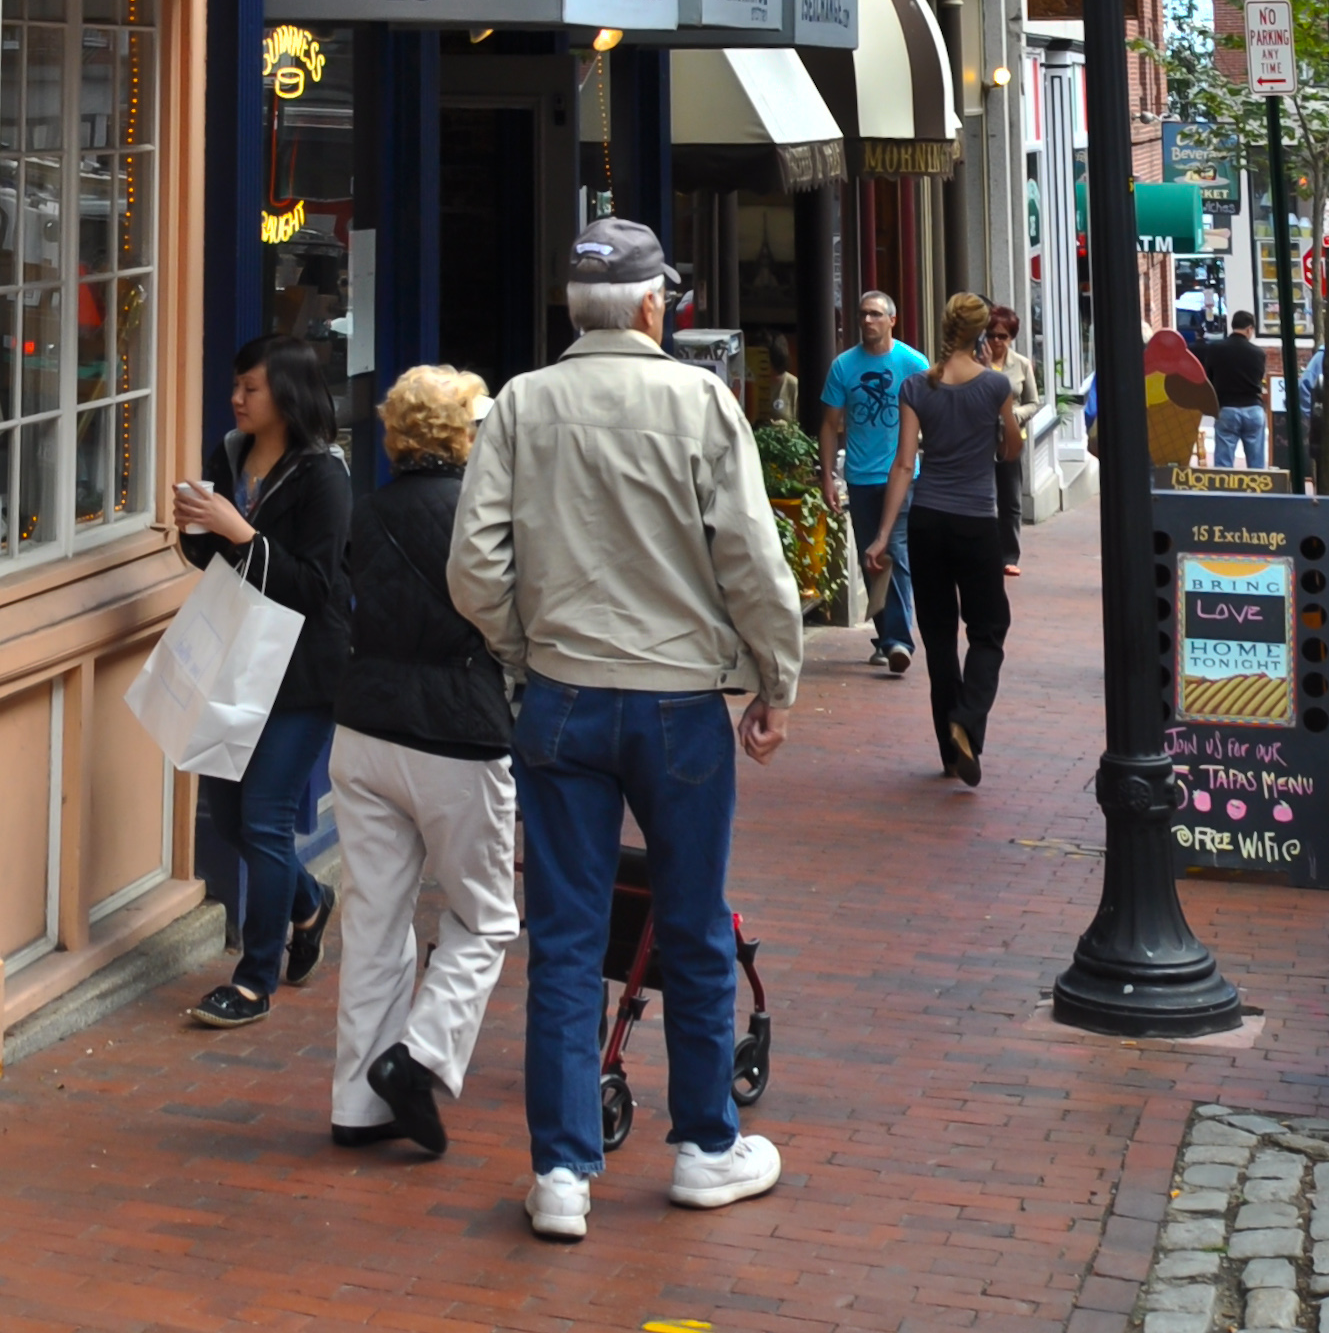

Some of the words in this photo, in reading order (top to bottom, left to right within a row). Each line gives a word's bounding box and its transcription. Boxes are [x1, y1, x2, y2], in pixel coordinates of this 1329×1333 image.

[1259, 8, 1276, 25] NO
[1250, 30, 1289, 46] PARKING
[1262, 49, 1279, 60] ANY
[1261, 62, 1283, 74] TIME
[261, 200, 305, 244] RAUGHT
[1172, 467, 1273, 492] Mornings
[1192, 525, 1209, 541] 15
[1213, 526, 1286, 550] Exchange
[1192, 579, 1280, 593] BRING
[1197, 599, 1263, 623] LOVE
[1190, 641, 1280, 658] HOME
[1190, 657, 1281, 671] TONIGHT
[1199, 765, 1257, 791] TAPAS
[1194, 826, 1234, 853] FREE
